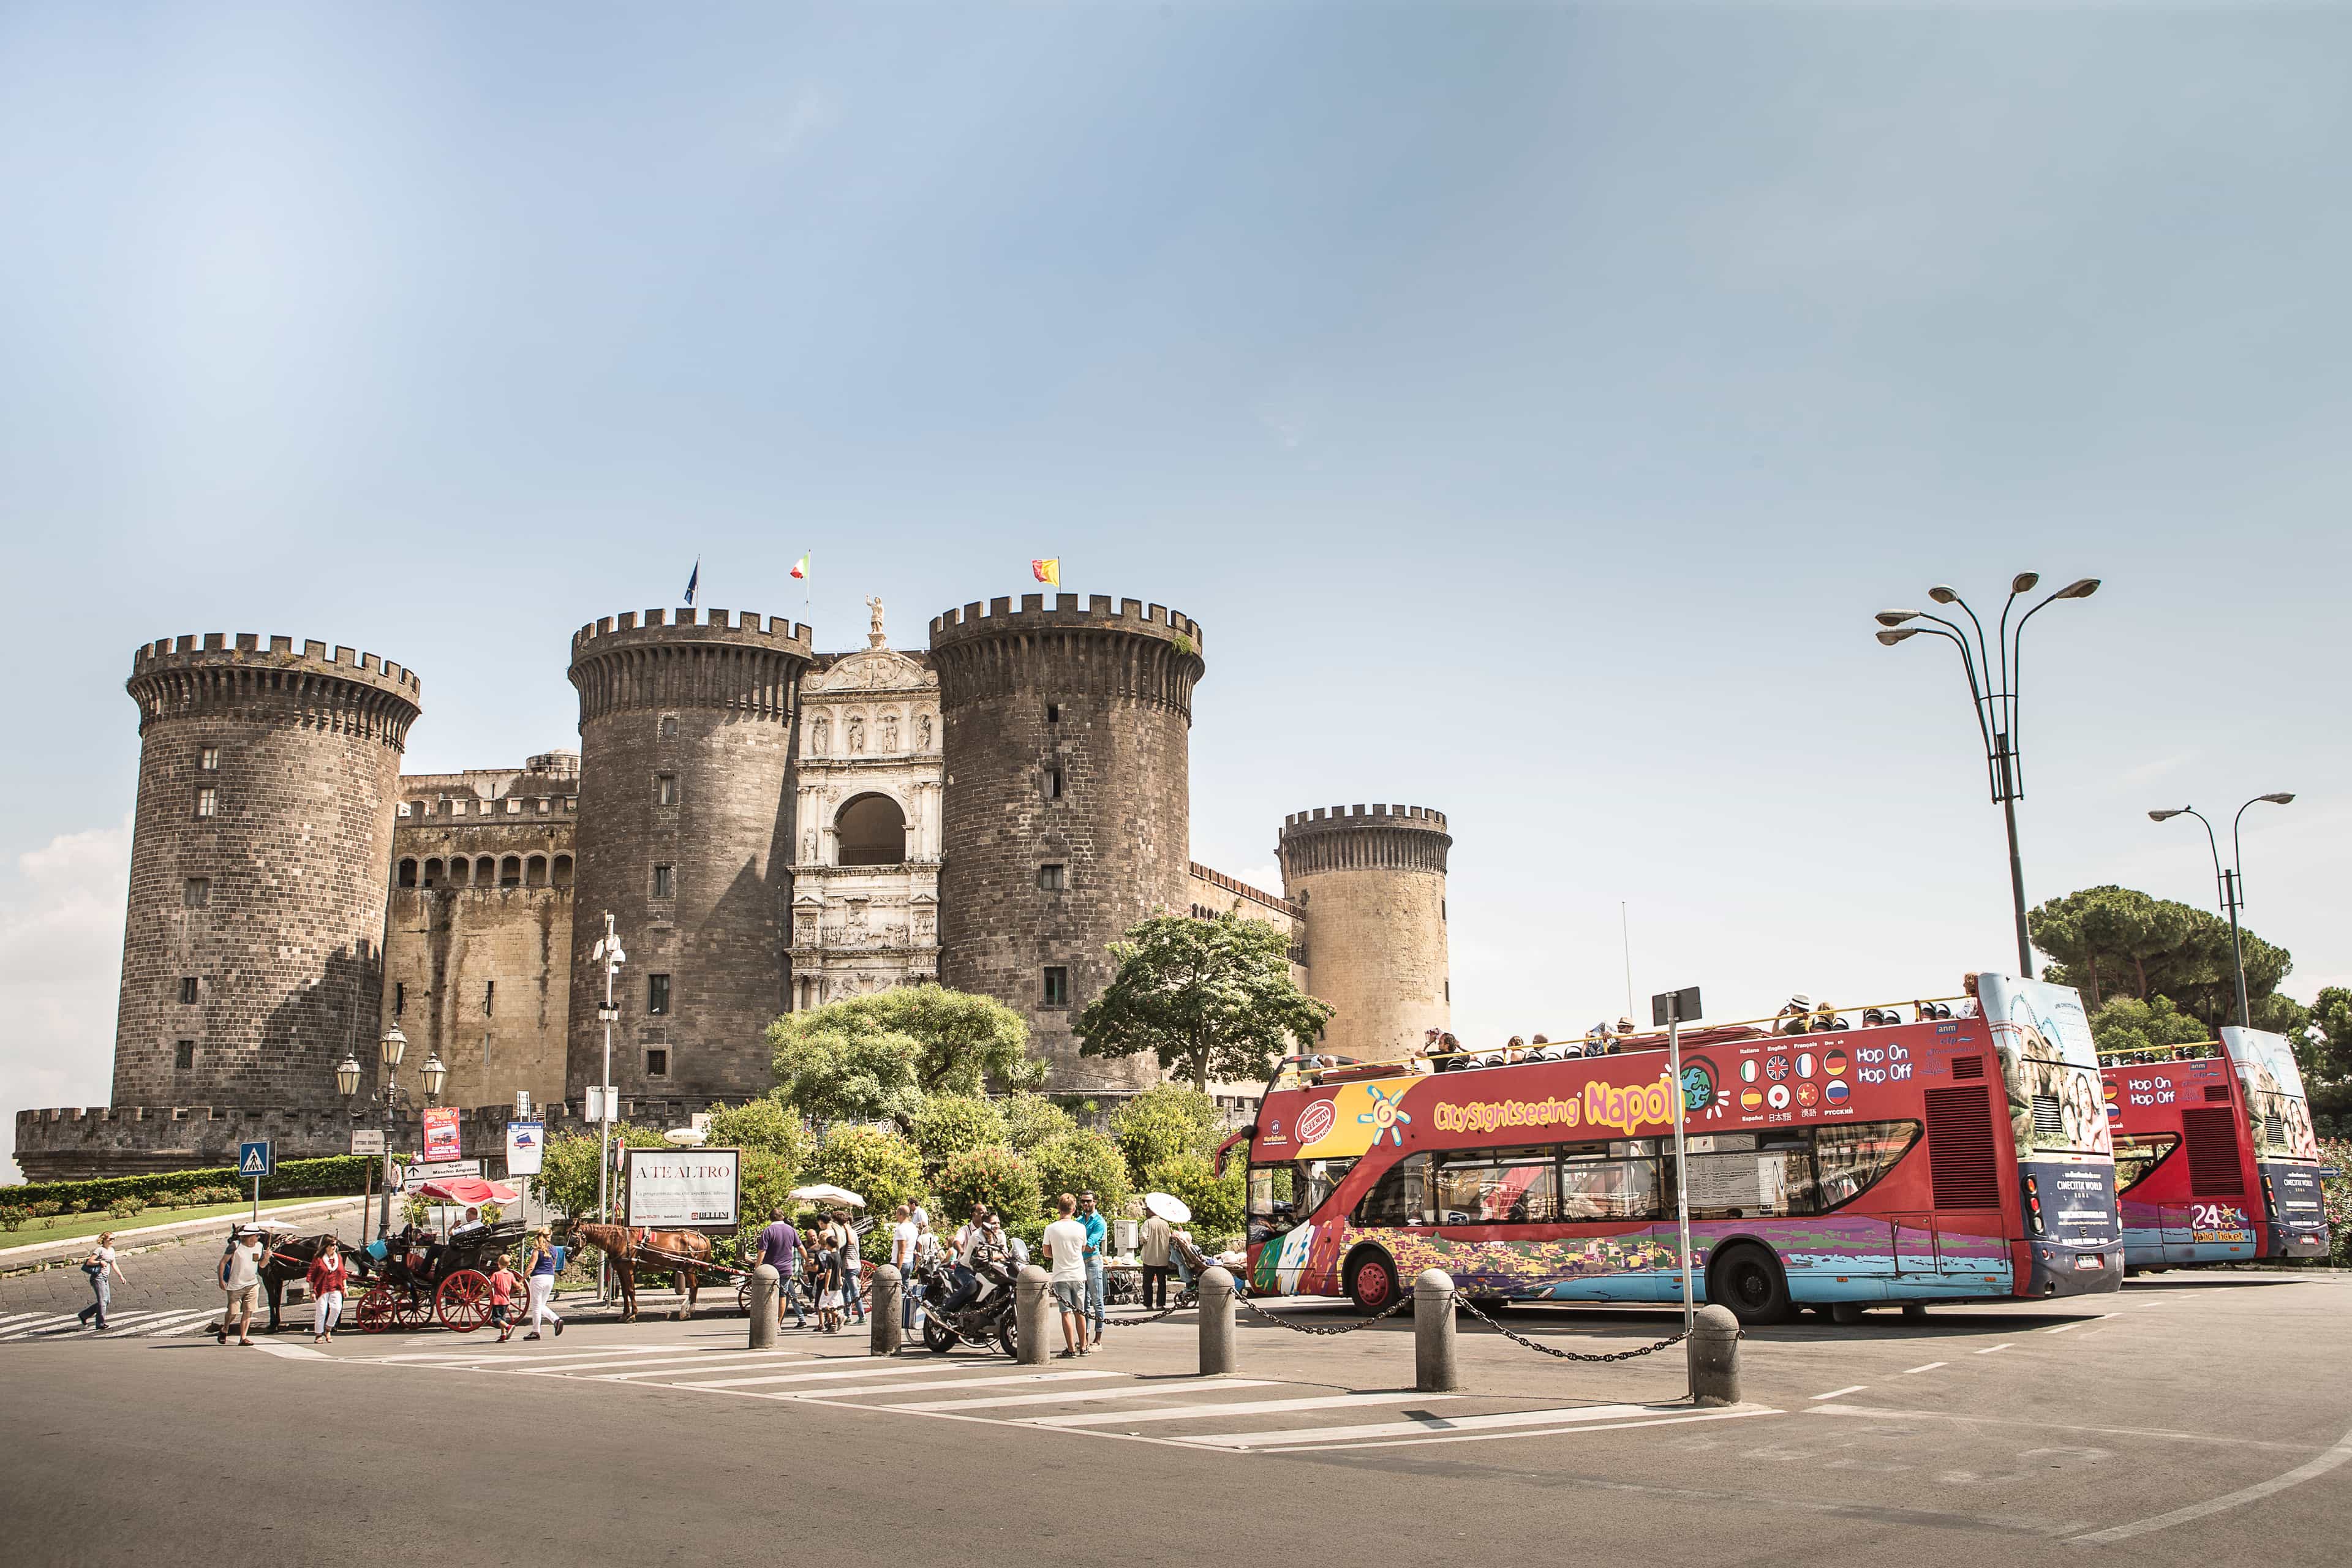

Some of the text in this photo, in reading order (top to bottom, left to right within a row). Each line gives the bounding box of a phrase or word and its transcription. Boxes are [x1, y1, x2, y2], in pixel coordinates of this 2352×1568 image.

[1856, 1048, 1885, 1064] Hop
[1888, 1044, 1909, 1060] On
[1858, 1063, 1913, 1084] Hop Off
[2128, 1079, 2152, 1091] Hop
[2155, 1076, 2171, 1089] On
[1434, 1076, 1685, 1136] CitySightseeing Napol
[2130, 1091, 2176, 1106] Hop Off
[1768, 1112, 1792, 1123] 日本語
[1824, 1106, 1854, 1116] РУССКИЙ
[1302, 1109, 1330, 1134] OFFICIAL
[636, 1166, 729, 1178] A TE ALTRO
[2085, 1182, 2103, 1191] WORLD
[2191, 1204, 2221, 1230] 24
[2193, 1230, 2244, 1242] Valid Ticket
